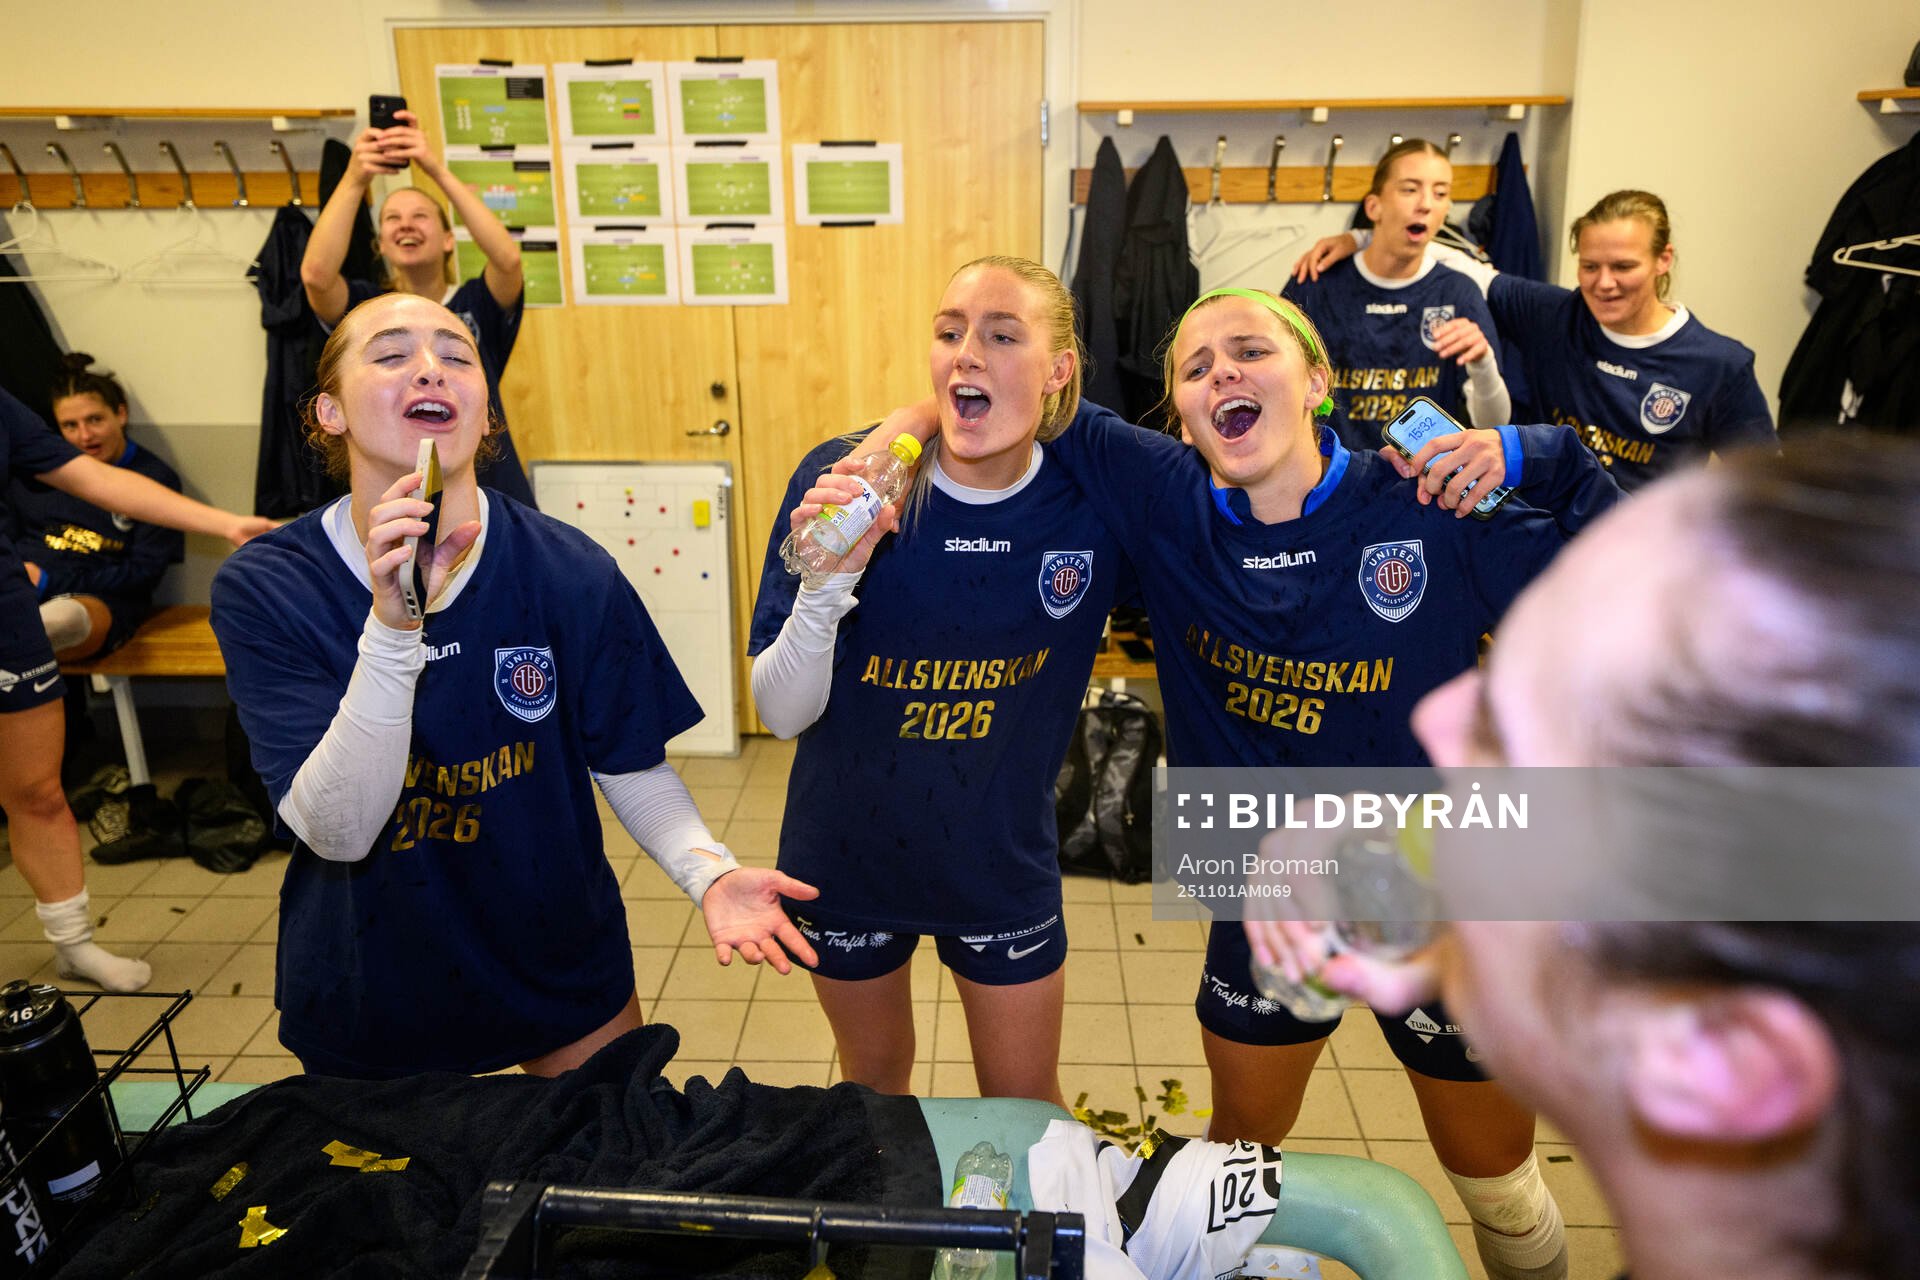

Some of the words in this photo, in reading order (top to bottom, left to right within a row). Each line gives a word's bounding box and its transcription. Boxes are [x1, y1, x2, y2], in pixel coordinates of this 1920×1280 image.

[1408, 416, 1437, 441] 15:32
[944, 537, 1011, 552] stadium
[1049, 556, 1086, 572] UNITED
[1242, 550, 1317, 569] stadium
[1369, 547, 1415, 567] UNITED
[1375, 590, 1414, 605] ESKILSTUNA
[504, 652, 549, 669] UNITED
[860, 647, 1050, 691] ALLSVENSKAN
[1185, 623, 1395, 693] ALLSVENSKAN
[1225, 680, 1326, 735] 2026
[899, 700, 996, 741] 2026
[404, 741, 536, 797] VENSKAN
[391, 797, 483, 851] 2026
[824, 930, 868, 952] Trafik
[1211, 976, 1250, 1007] Trafik
[9, 1007, 34, 1024] 16
[1410, 1020, 1436, 1031] TUNA
[1222, 1168, 1257, 1213] 20
